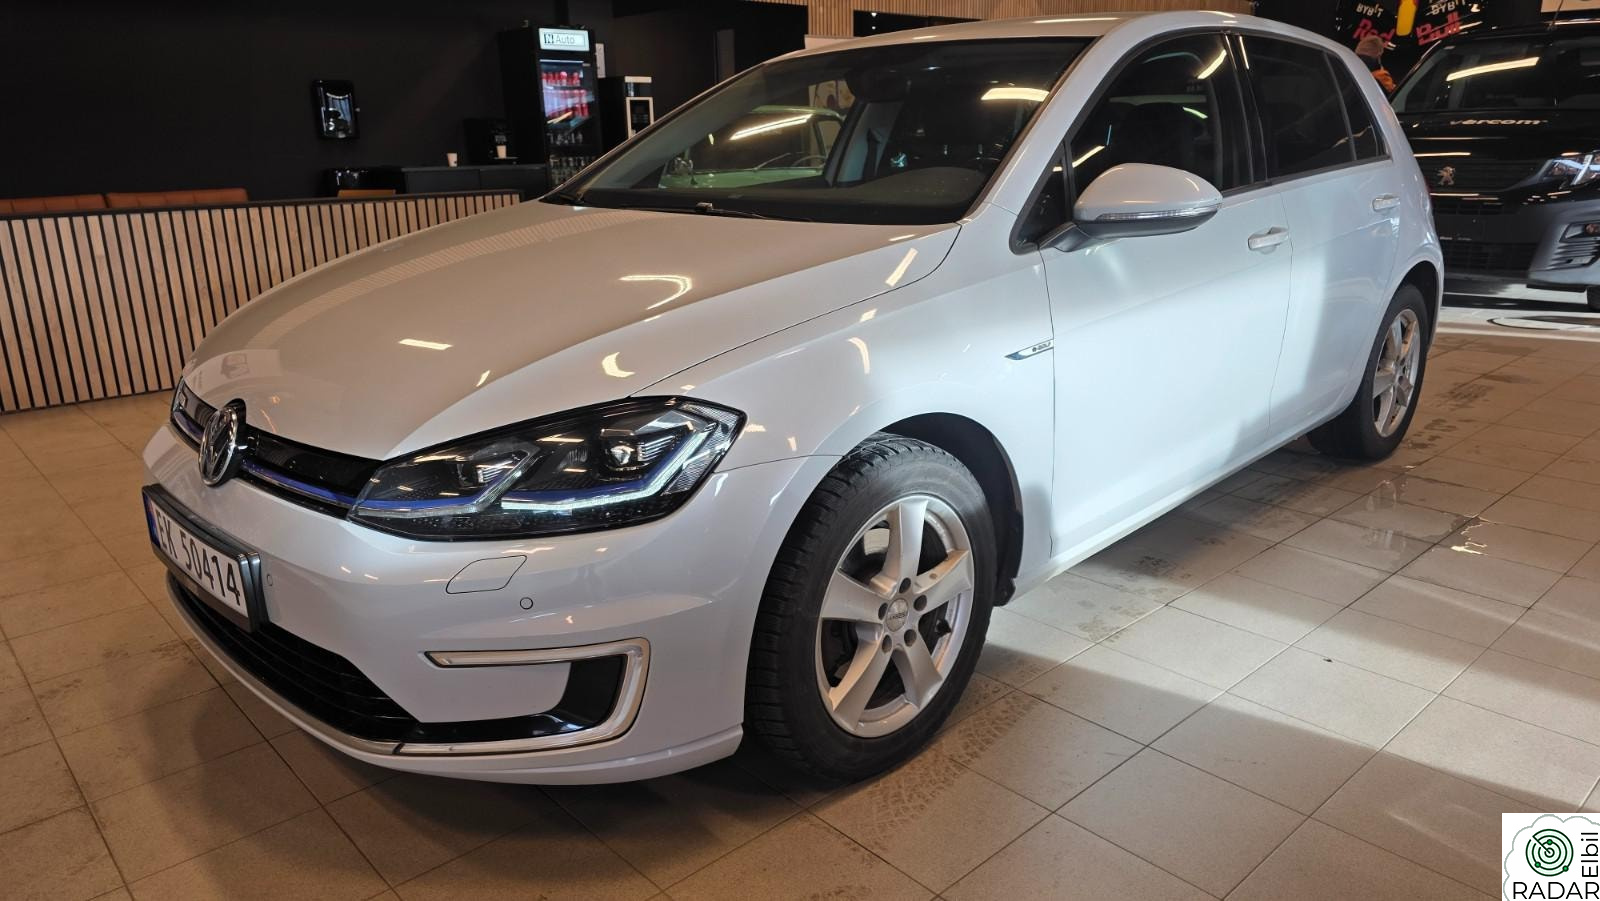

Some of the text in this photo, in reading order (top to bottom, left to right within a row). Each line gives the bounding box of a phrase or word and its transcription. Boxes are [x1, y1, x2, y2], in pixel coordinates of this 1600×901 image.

[1356, 3, 1384, 18] BYBIT
[155, 508, 241, 607] EK 50414
